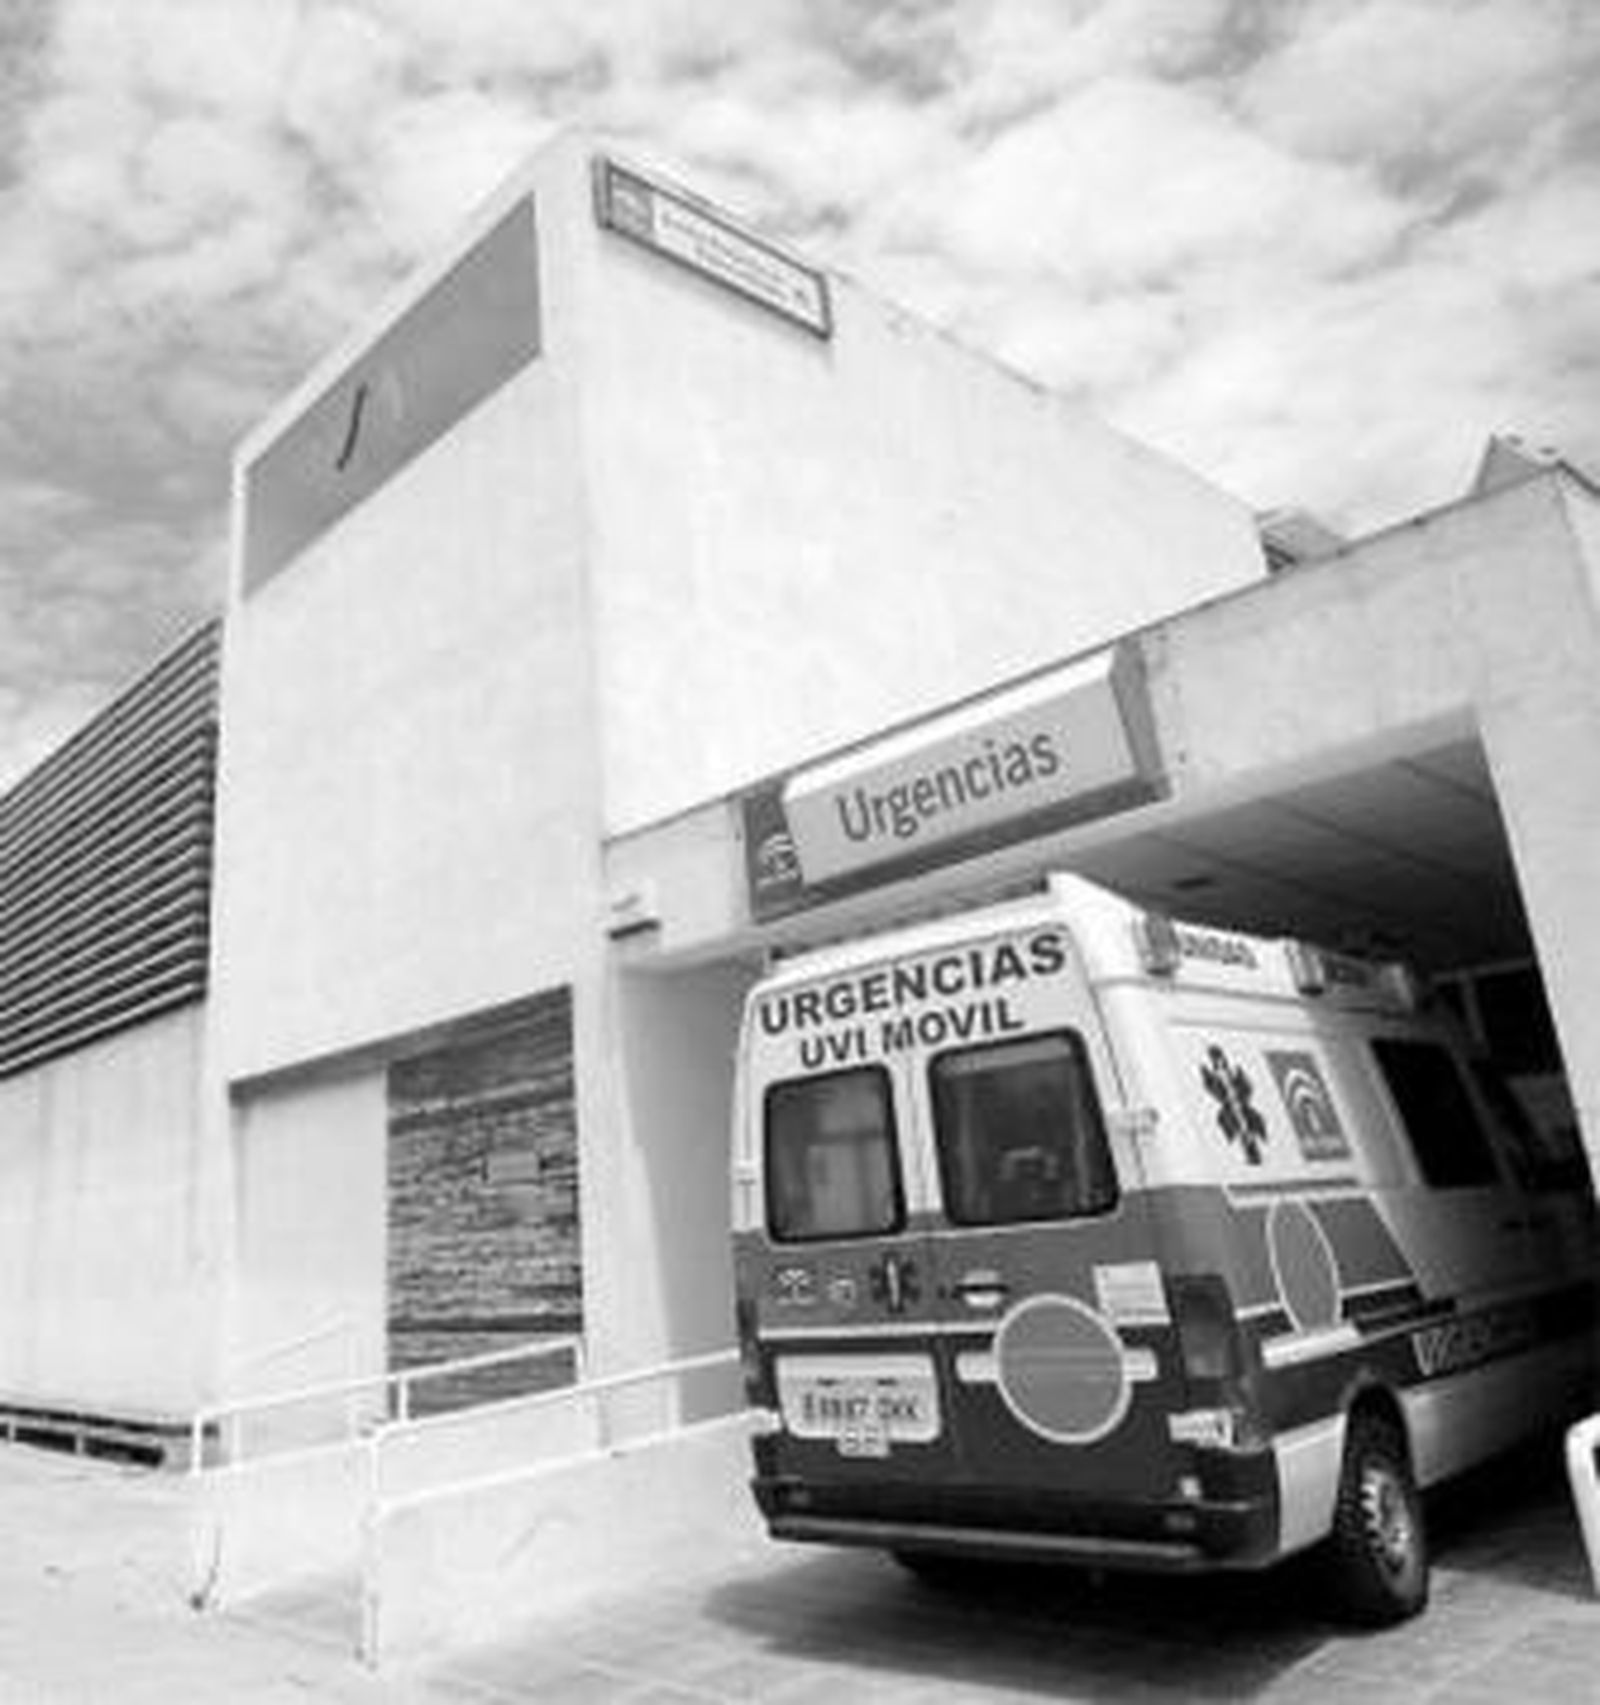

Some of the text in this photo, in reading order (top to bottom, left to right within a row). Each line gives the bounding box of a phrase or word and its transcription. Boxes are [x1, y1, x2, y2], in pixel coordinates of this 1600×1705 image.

[834, 732, 1060, 842] Urgencias
[760, 934, 1066, 1034] URGENCIAS
[799, 997, 1024, 1070] UVI MOVIL
